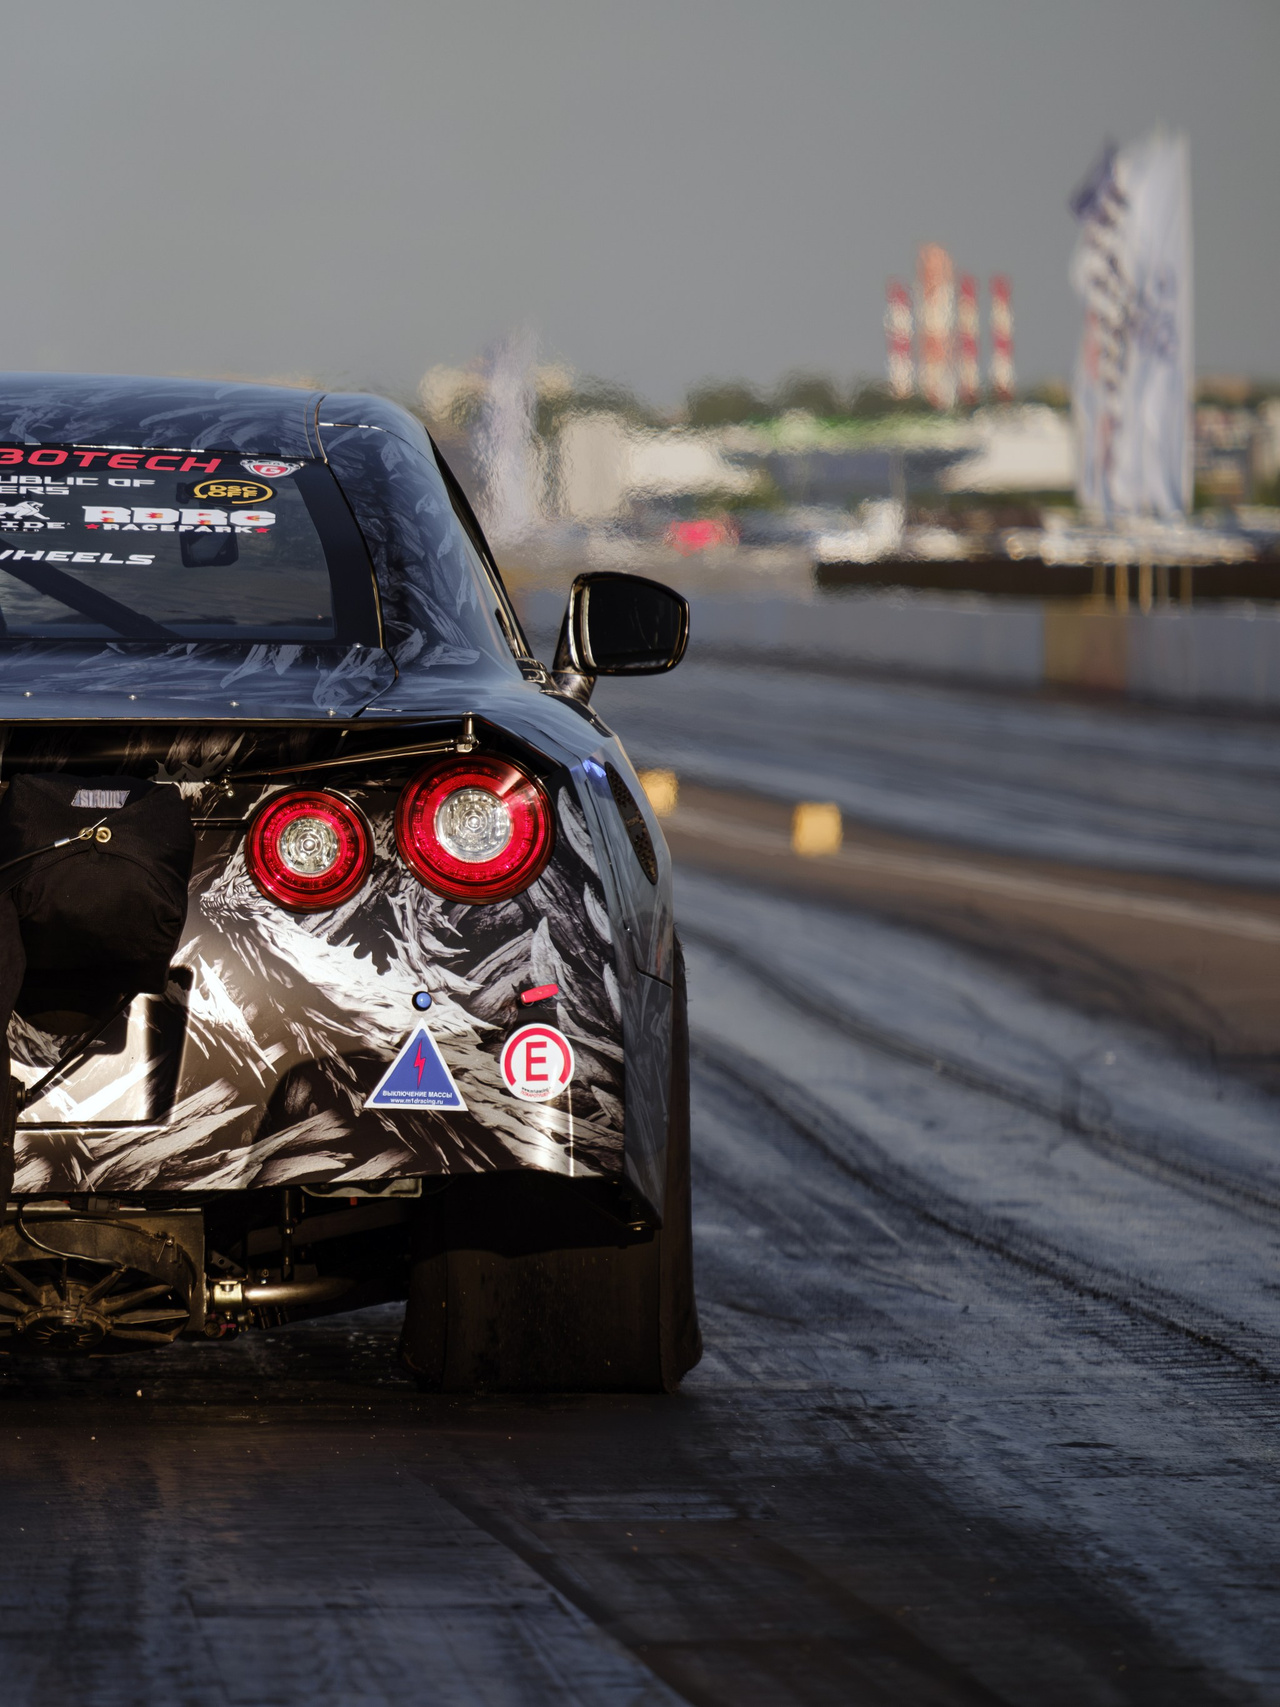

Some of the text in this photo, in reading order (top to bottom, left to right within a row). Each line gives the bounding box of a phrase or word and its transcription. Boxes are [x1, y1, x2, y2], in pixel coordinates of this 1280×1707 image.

[108, 478, 156, 488] OF
[209, 484, 259, 492] DSC
[207, 490, 259, 498] OFF
[103, 523, 253, 534] RACEPARK
[525, 1041, 549, 1082] E
[382, 1089, 453, 1099] ВЫКЛЮЧЕНИЕ МАССЫ
[390, 1097, 444, 1105] www.m1dracing.ru
